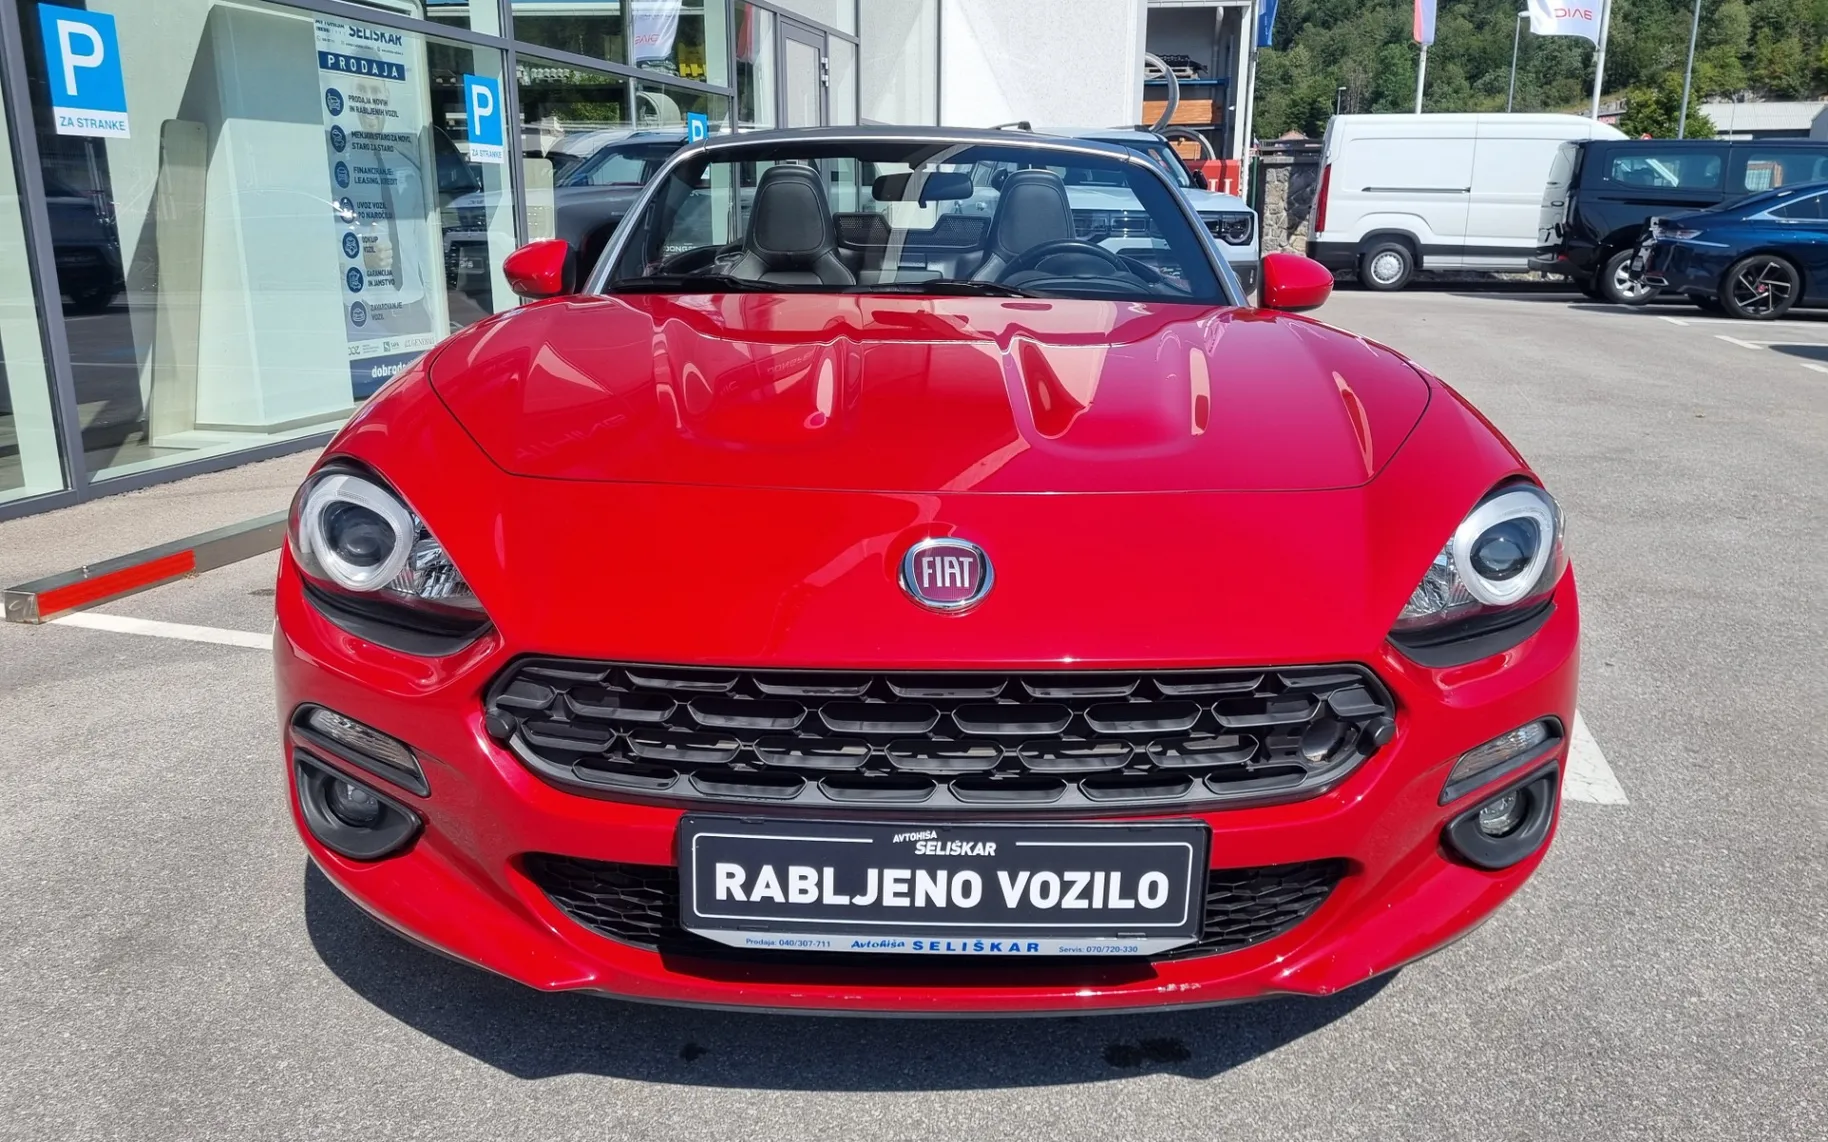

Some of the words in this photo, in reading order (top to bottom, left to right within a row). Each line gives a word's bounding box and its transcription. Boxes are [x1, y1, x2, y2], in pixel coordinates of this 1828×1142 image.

[56, 19, 104, 96] P
[327, 54, 398, 78] PRODAJA
[348, 94, 371, 104] PRODAJA
[472, 84, 493, 136] P
[60, 116, 74, 127] ZA
[77, 117, 126, 130] STRANKE
[922, 556, 974, 588] FIAT
[892, 830, 937, 843] AVTOHIŠA
[914, 840, 996, 856] SELIŠKAR
[715, 862, 983, 909] RABLJENO
[996, 870, 1169, 909] VOZILO
[746, 938, 777, 946] Prodaja:
[779, 939, 831, 948] 040/307-711
[851, 939, 905, 948] Avtohiša
[912, 940, 1040, 952] SELIŠKAR
